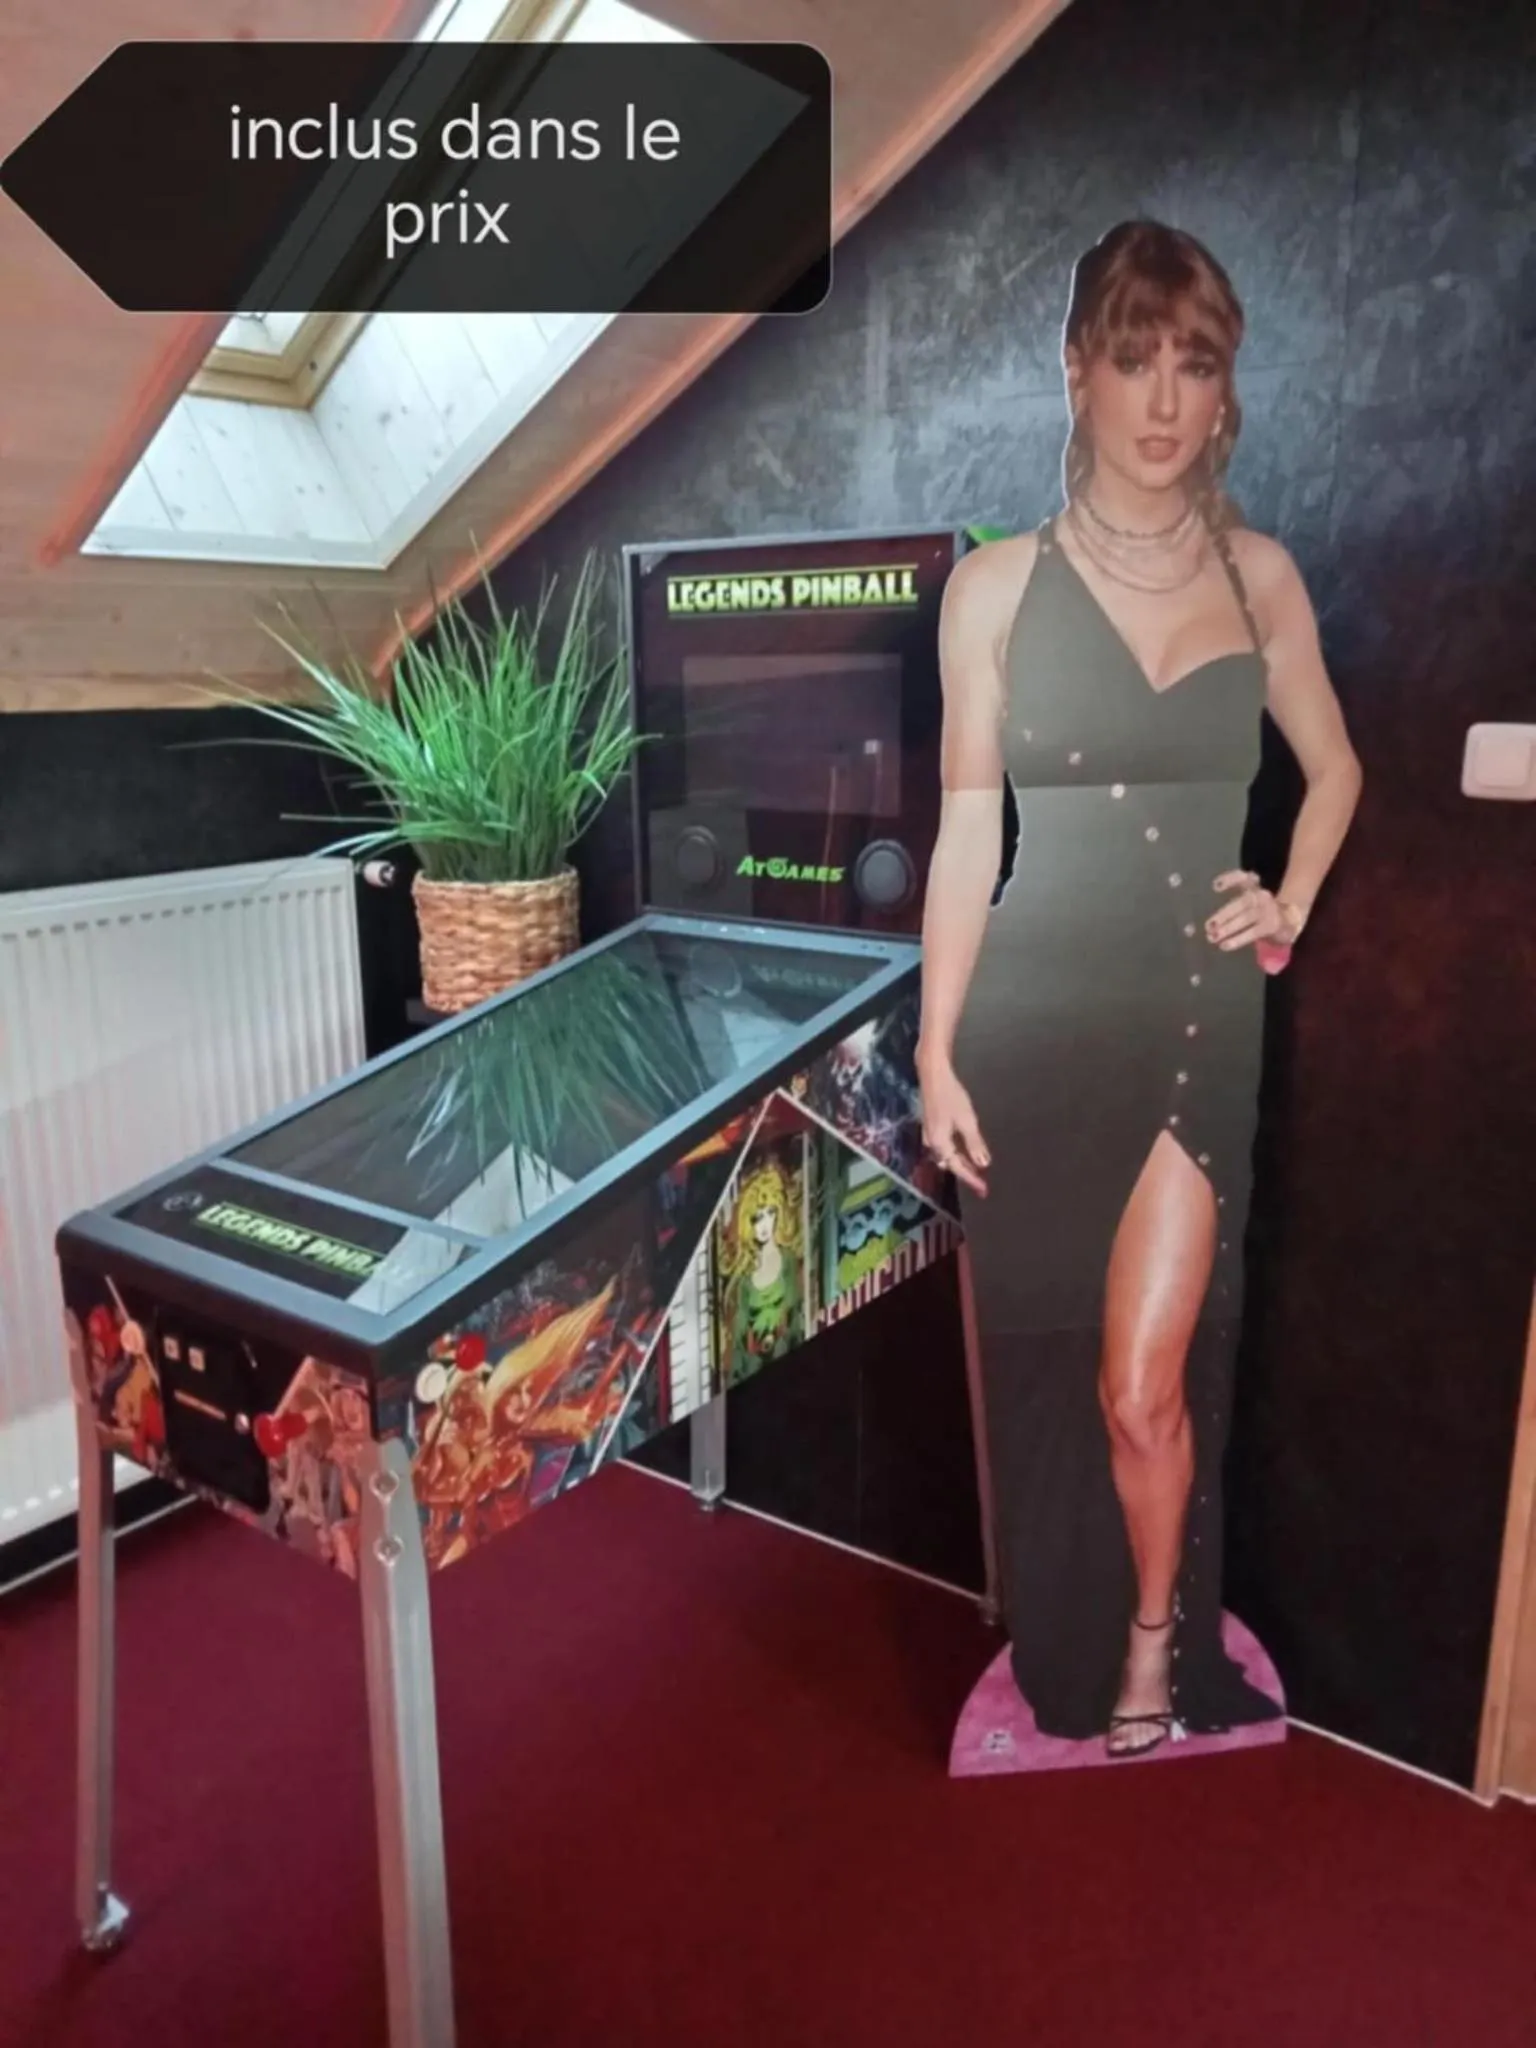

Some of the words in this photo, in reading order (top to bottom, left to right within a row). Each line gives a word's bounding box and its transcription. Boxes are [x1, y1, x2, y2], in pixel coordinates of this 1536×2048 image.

[667, 577, 787, 613] LEGENDS
[792, 571, 918, 608] PINBALL
[197, 1203, 311, 1251] LEGENDS
[300, 1235, 386, 1277] PINB
